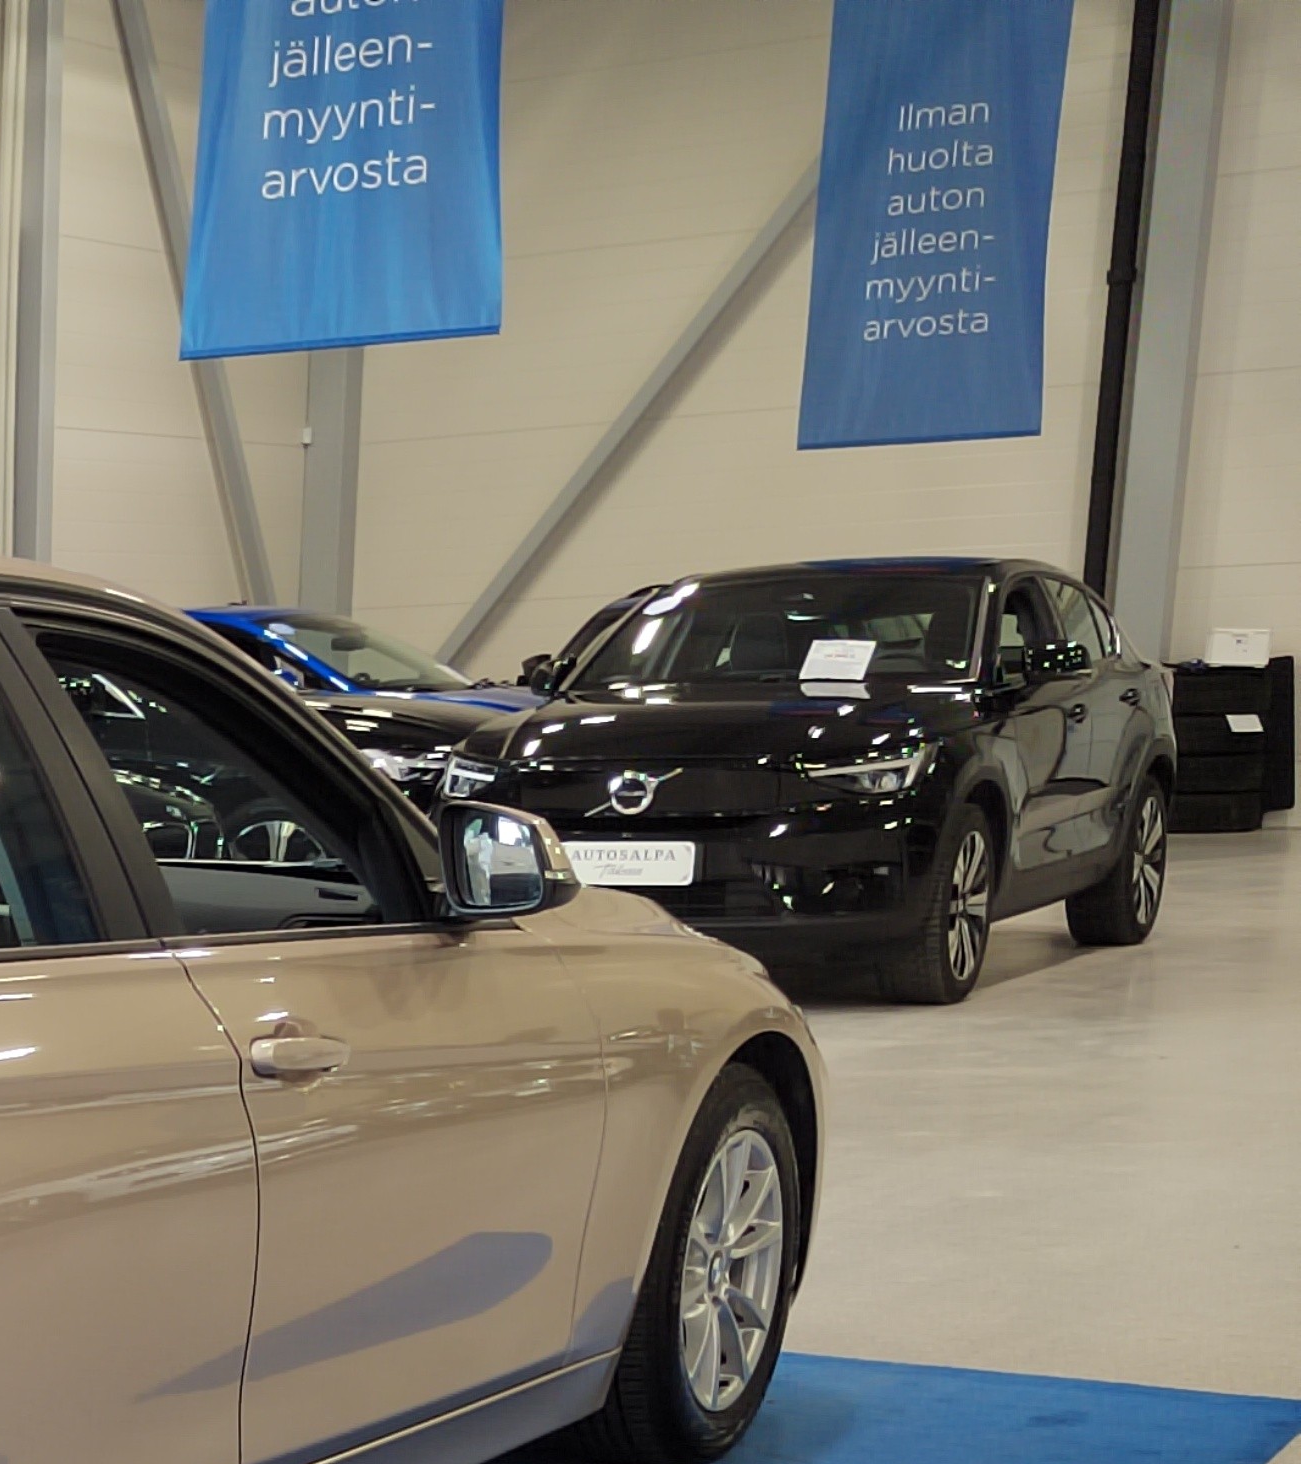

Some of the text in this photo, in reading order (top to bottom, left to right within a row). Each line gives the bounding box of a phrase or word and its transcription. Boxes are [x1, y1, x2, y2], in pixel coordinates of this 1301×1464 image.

[268, 33, 433, 88] jälleen-
[262, 85, 436, 144] myynti-
[898, 101, 990, 132] Ilman
[261, 150, 428, 200] arvosta
[887, 139, 994, 175] huolta
[887, 185, 985, 217] auton
[870, 228, 995, 265] jälleen-
[865, 264, 997, 303] myynti-
[863, 308, 989, 342] arvosta
[571, 849, 676, 861] AUTOSALPA
